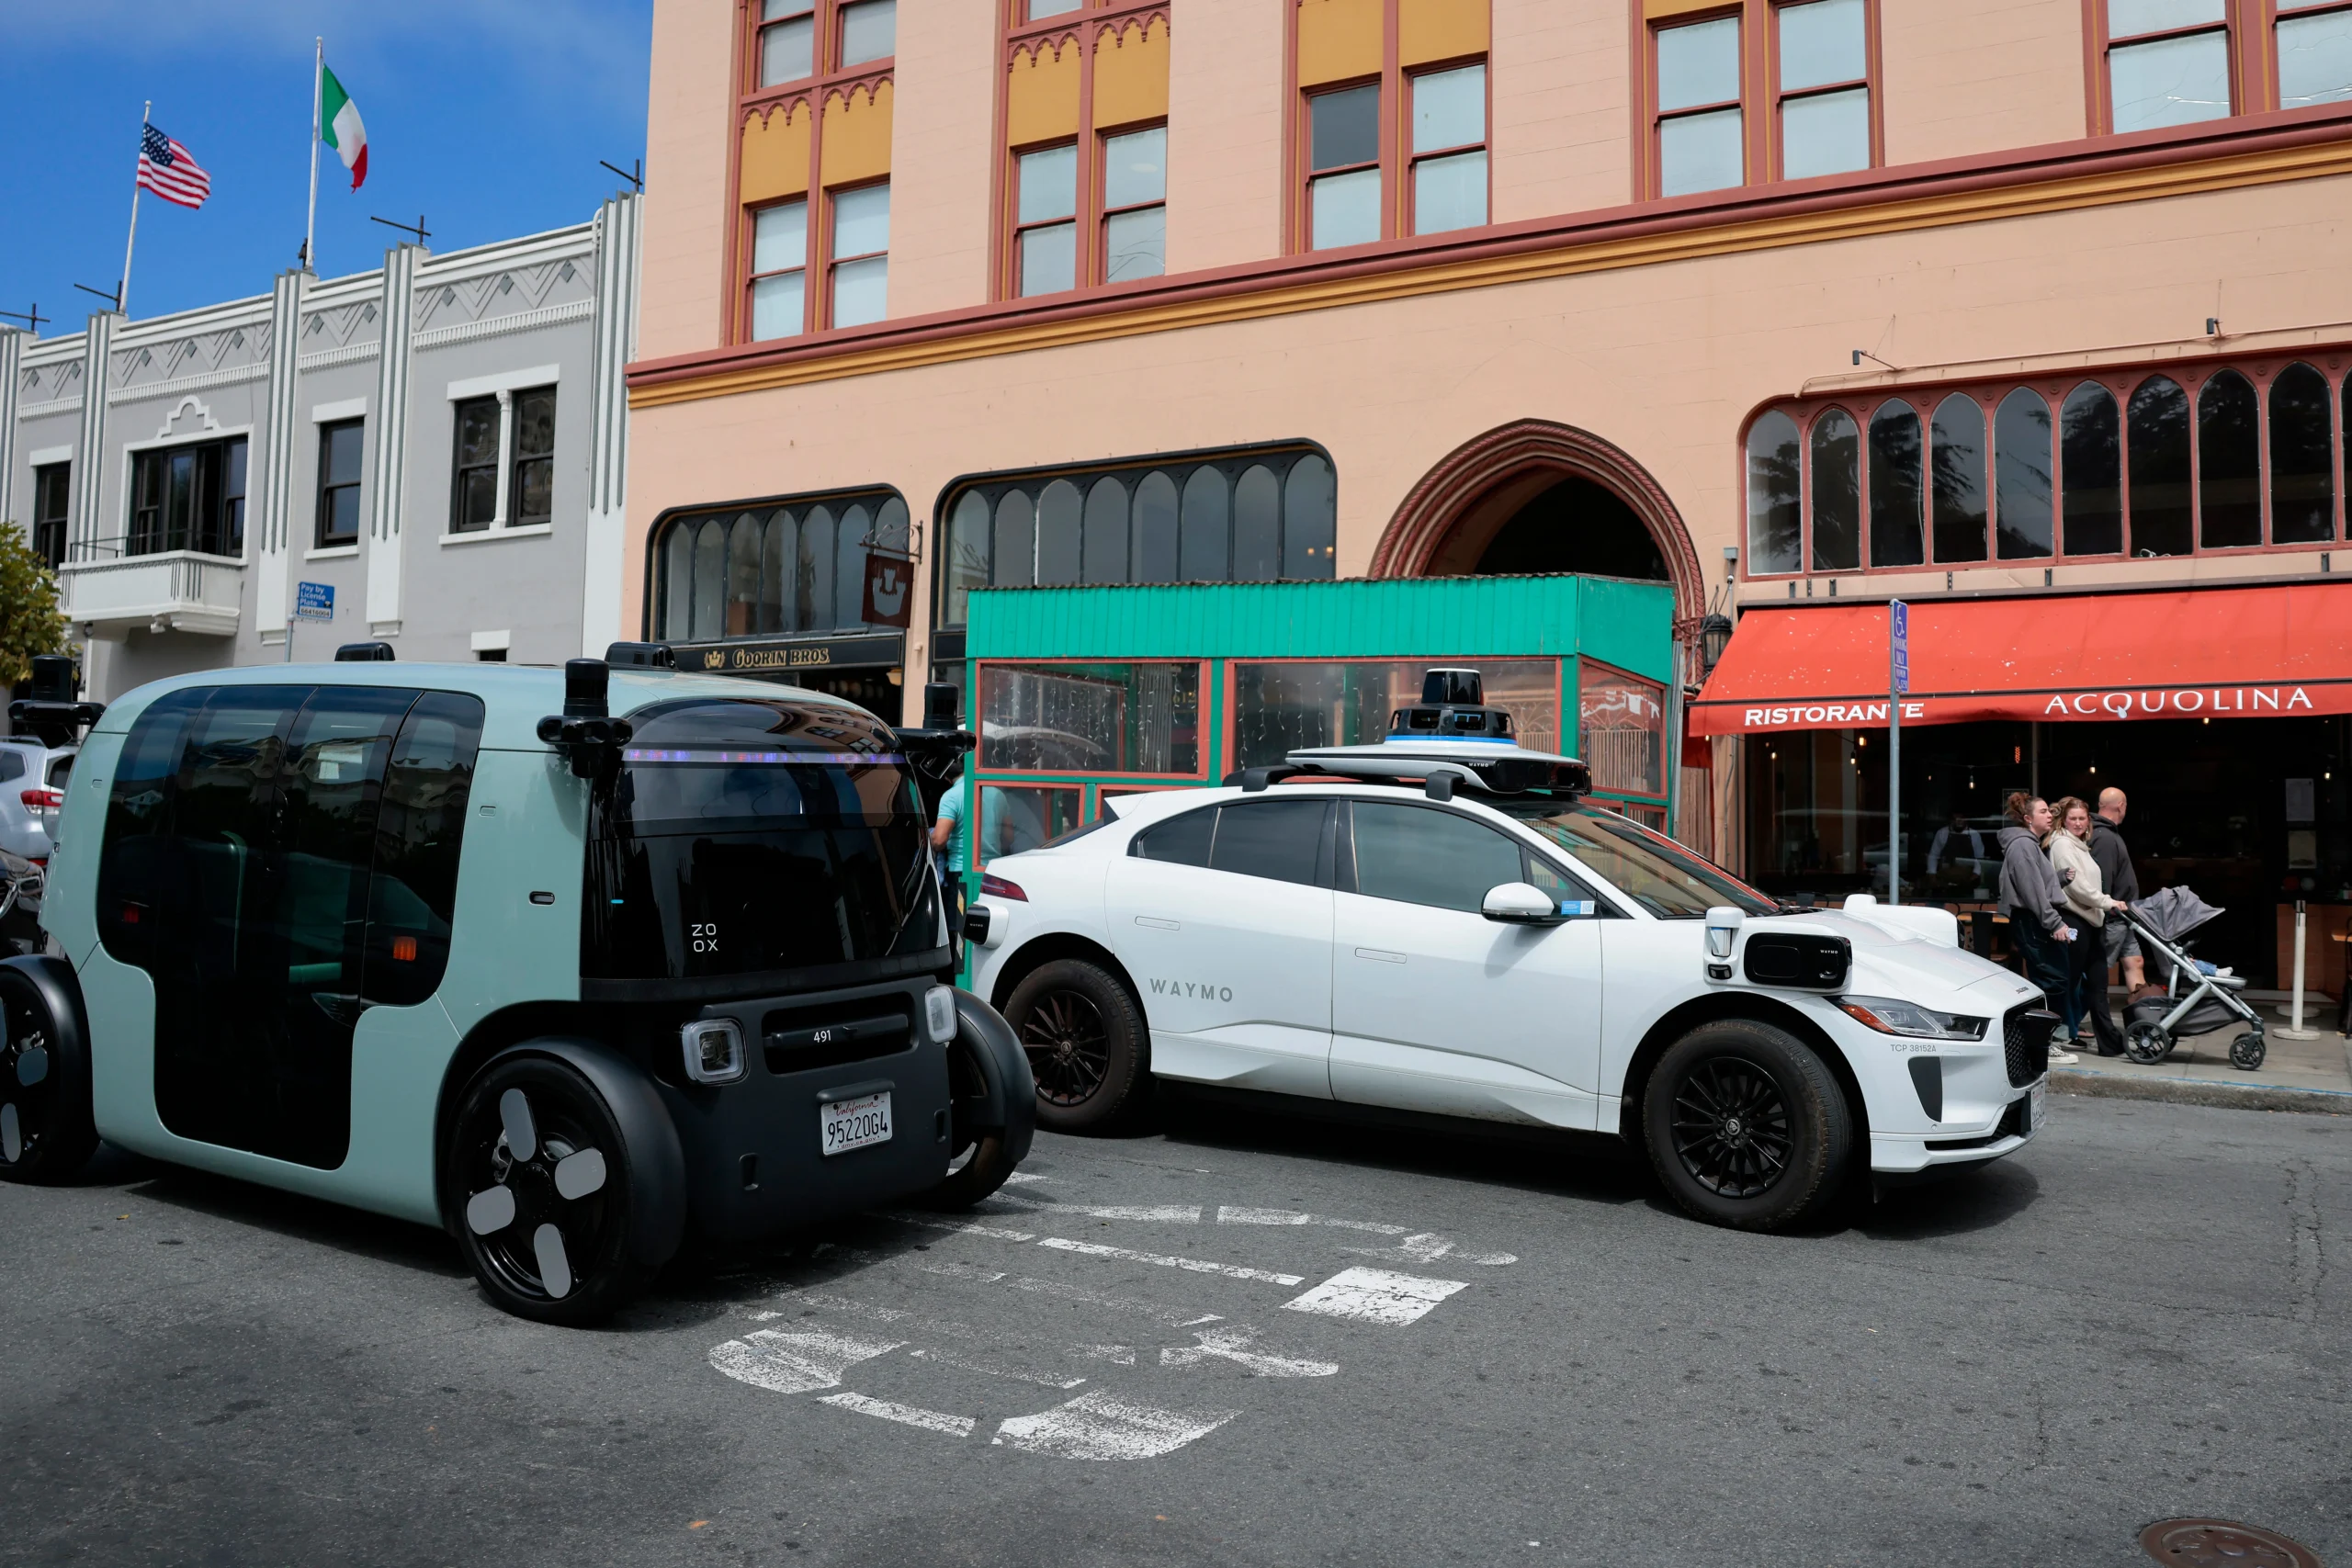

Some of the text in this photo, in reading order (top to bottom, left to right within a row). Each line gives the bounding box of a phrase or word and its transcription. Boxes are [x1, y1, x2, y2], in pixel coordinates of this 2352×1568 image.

[300, 583, 324, 594] Pay by
[300, 591, 326, 601] License
[300, 598, 318, 606] Plate
[732, 648, 787, 668] GOORIN
[2045, 687, 2313, 719] ACQUOLINA
[1149, 977, 1233, 1003] WAYMO
[813, 1029, 831, 1043] 491
[1890, 1043, 1937, 1053] TCP 38152A
[835, 1101, 878, 1116] California
[827, 1110, 888, 1147] 95220G4
[841, 1136, 876, 1149] dmv.ca.gov
